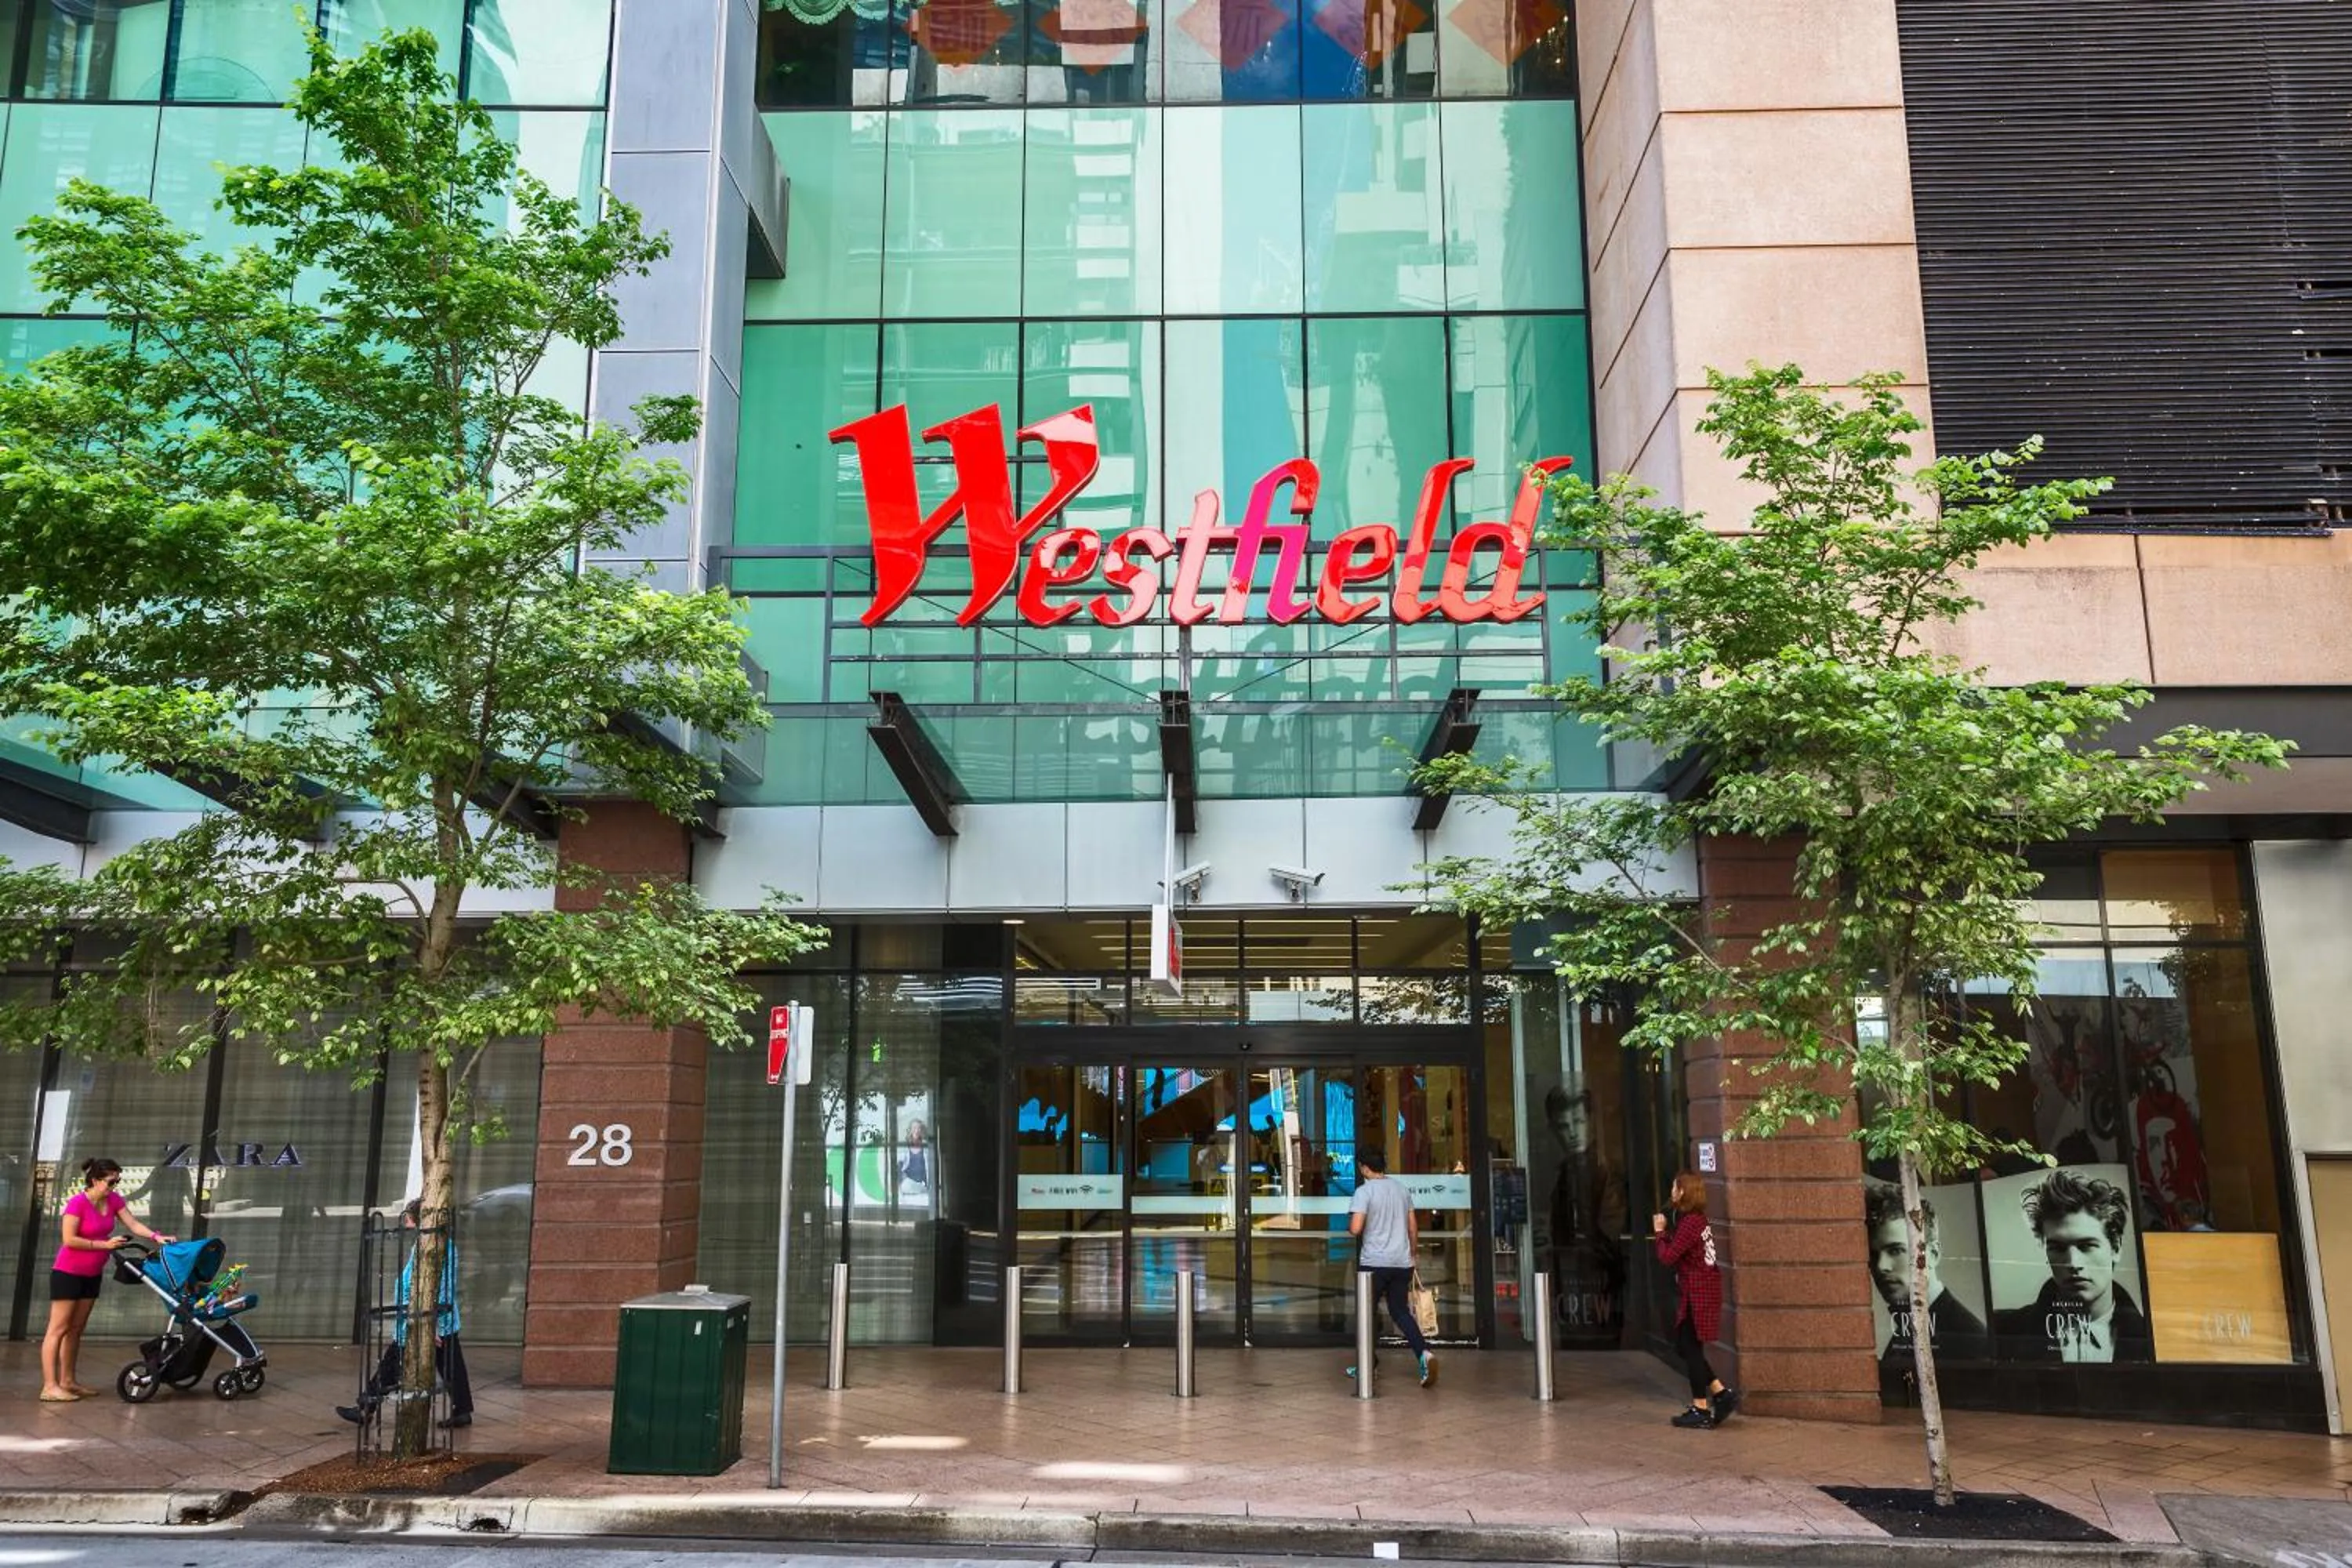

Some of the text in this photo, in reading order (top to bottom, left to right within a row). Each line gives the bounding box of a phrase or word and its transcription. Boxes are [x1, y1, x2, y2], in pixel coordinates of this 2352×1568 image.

[827, 402, 1574, 627] Westfield
[567, 1123, 633, 1167] 28
[1555, 1294, 1611, 1324] CREW
[1890, 1312, 1936, 1338] CRW
[2045, 1313, 2092, 1339] CREW
